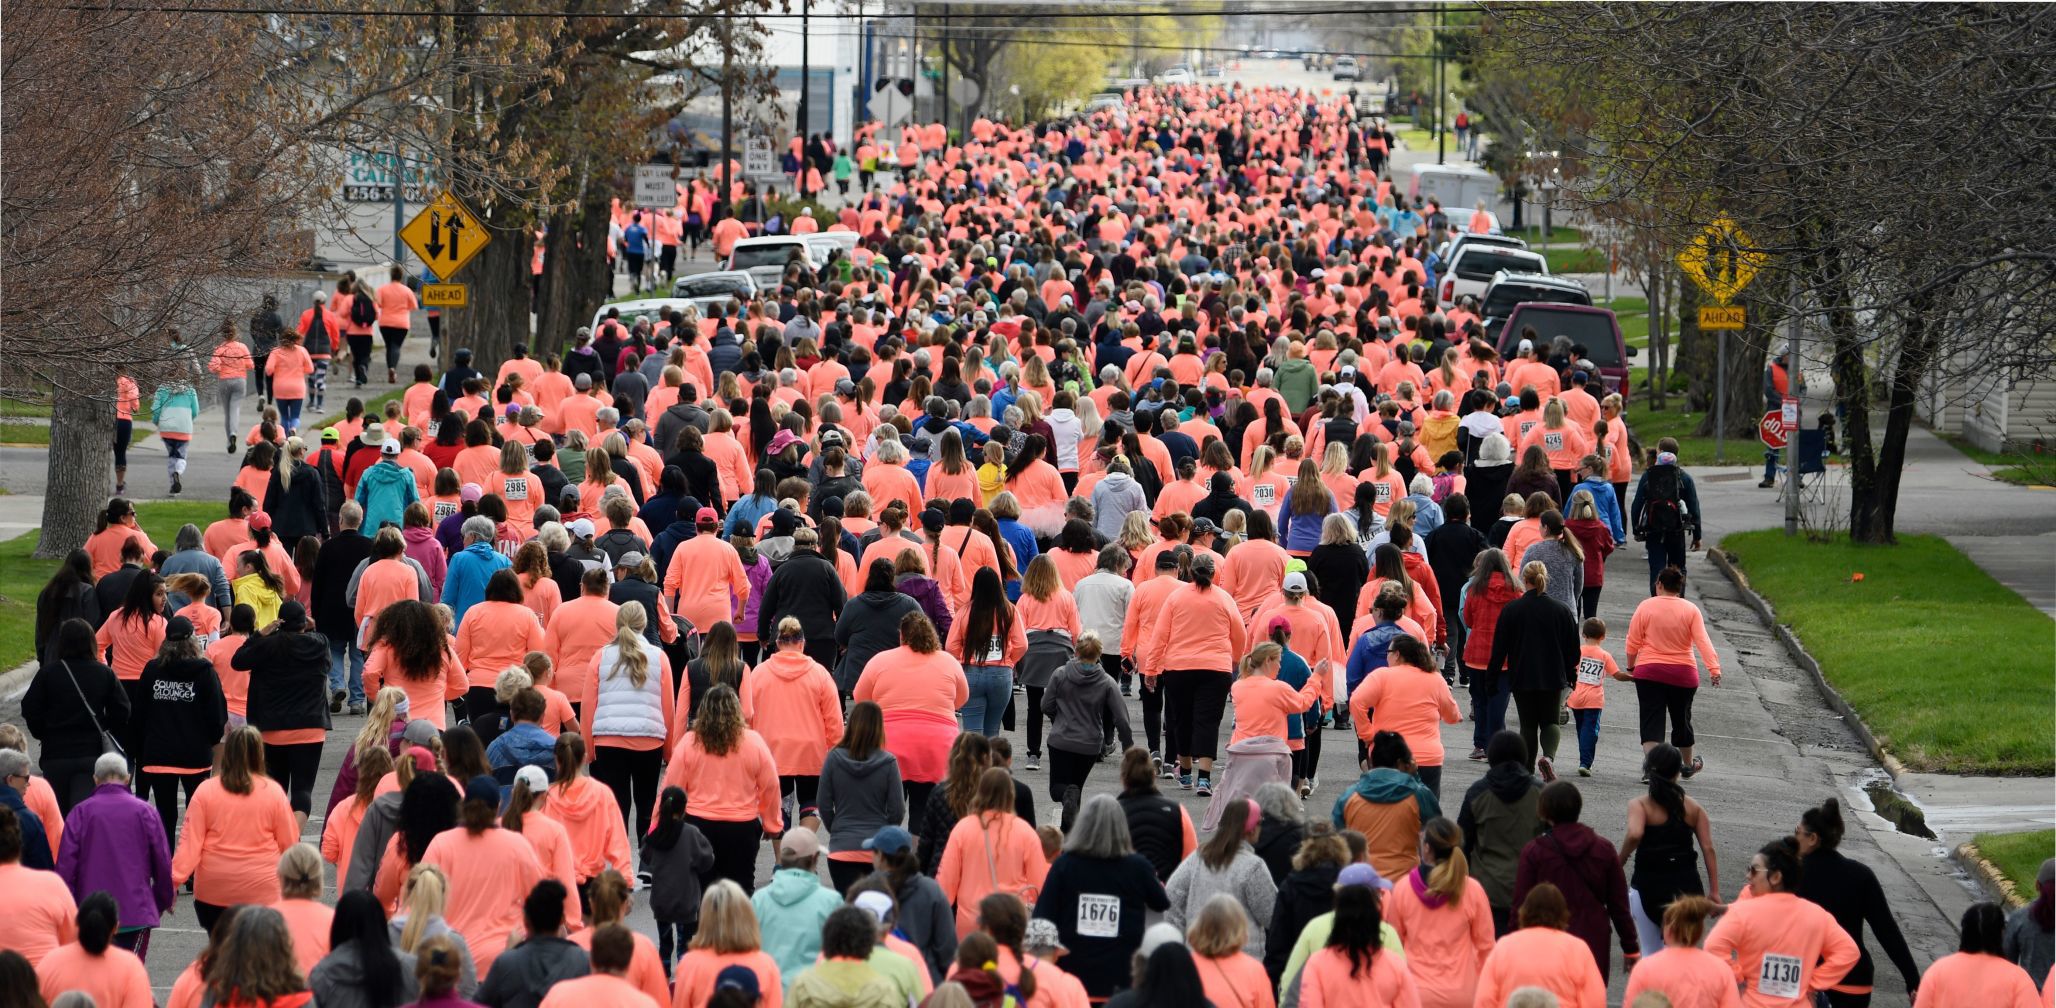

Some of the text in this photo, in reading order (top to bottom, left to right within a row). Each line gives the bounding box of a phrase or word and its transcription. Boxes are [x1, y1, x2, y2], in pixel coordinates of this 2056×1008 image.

[749, 152, 768, 160] ONE
[748, 161, 768, 170] WAY
[645, 182, 665, 190] MUST
[637, 194, 673, 203] TURN LEFT
[427, 290, 462, 301] AHEAD
[1704, 312, 1741, 323] AHEAD
[1545, 436, 1562, 445] 4245
[505, 481, 527, 493] 2985
[1254, 488, 1274, 498] 2030
[435, 505, 457, 517] 2986
[1579, 661, 1604, 677] 5227
[159, 688, 191, 699] LOUNGE
[1080, 902, 1118, 922] 1676
[1762, 961, 1801, 984] 1130
